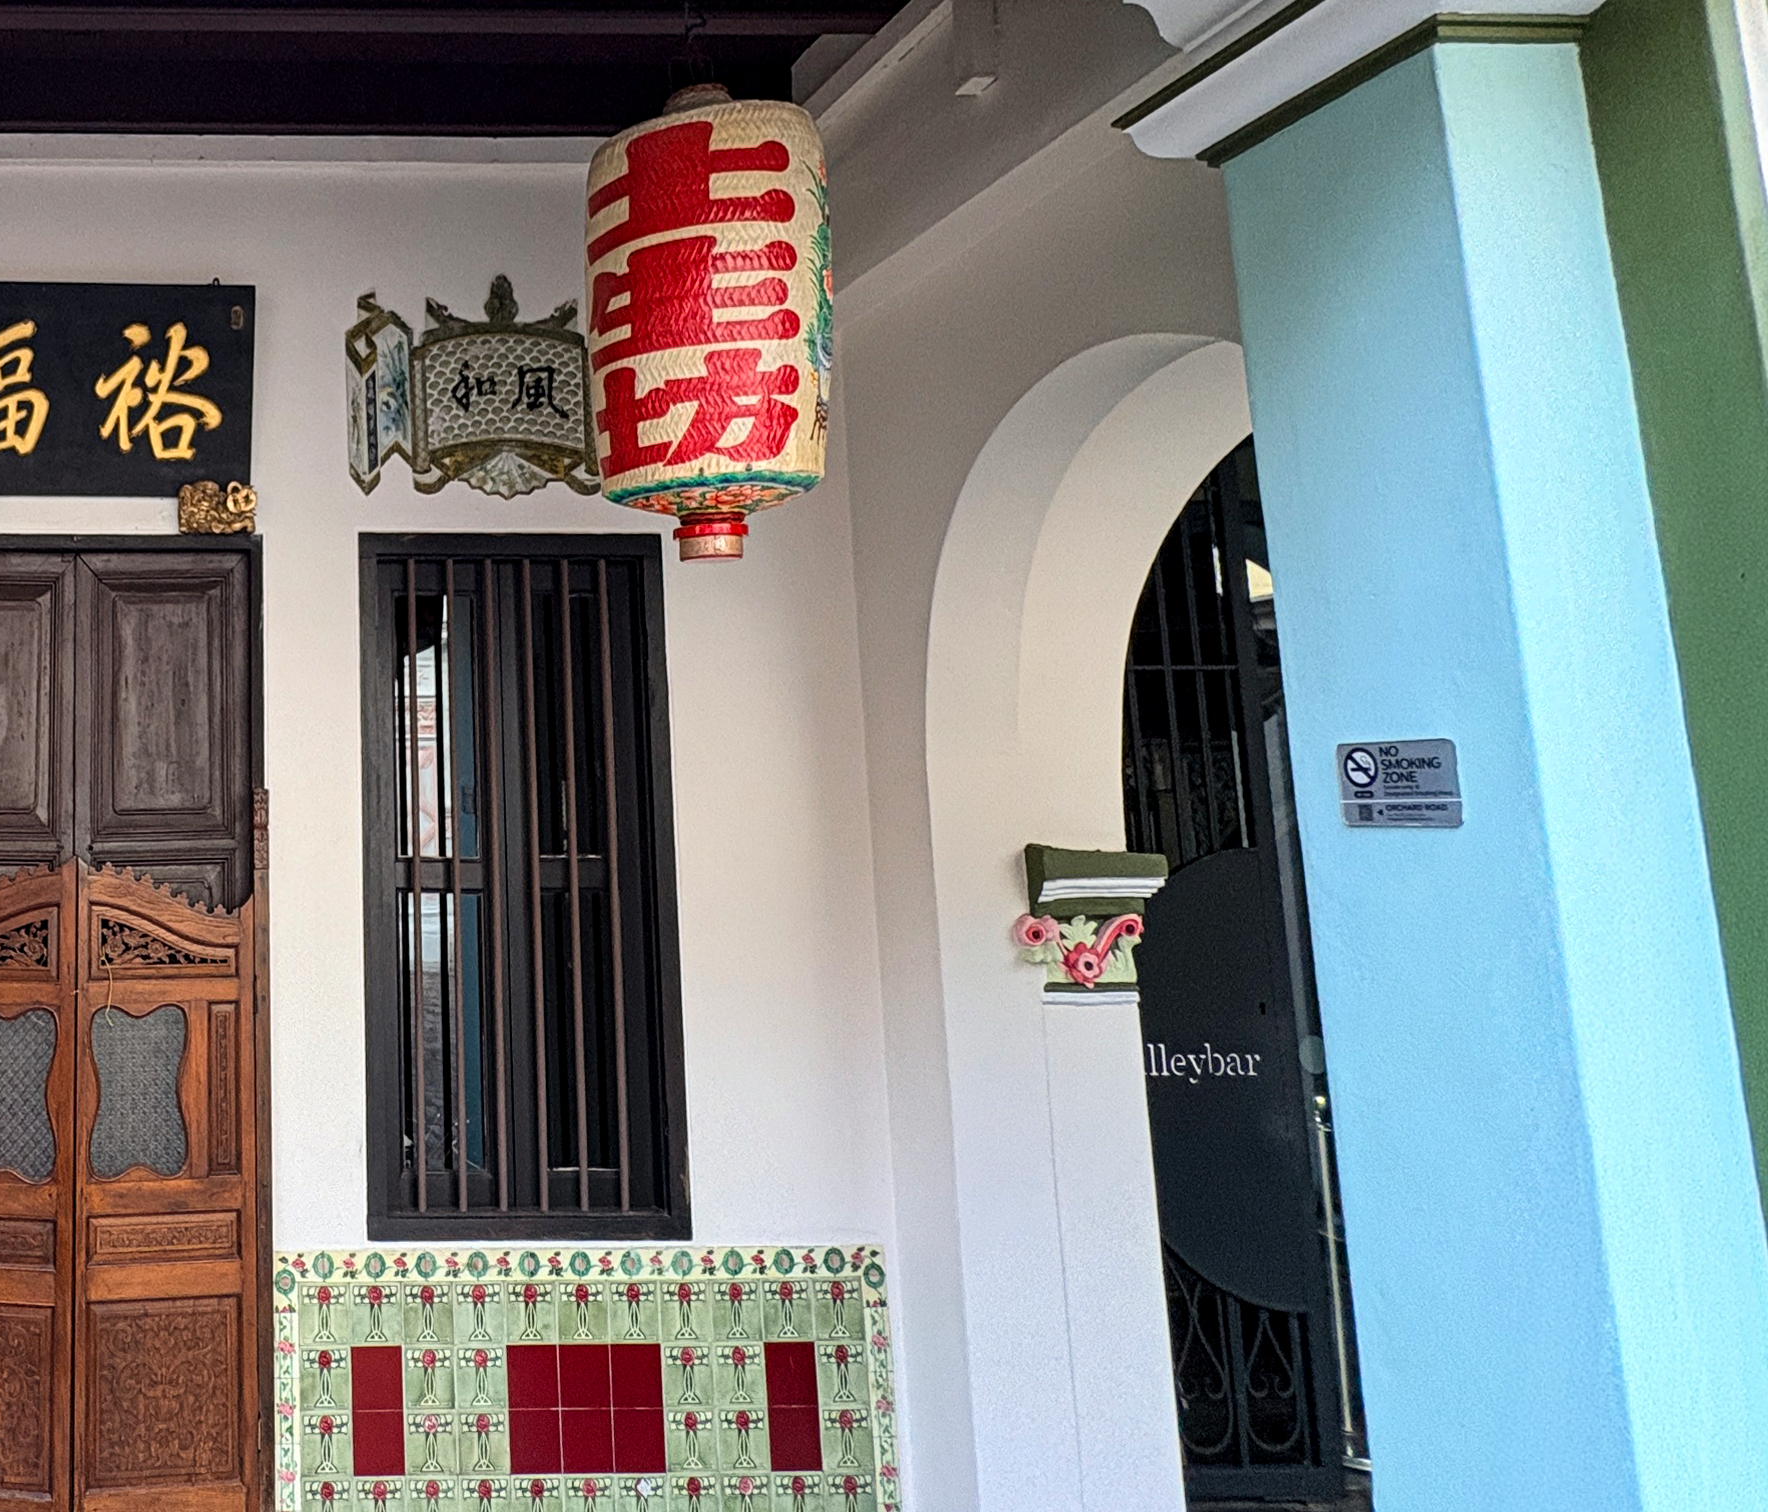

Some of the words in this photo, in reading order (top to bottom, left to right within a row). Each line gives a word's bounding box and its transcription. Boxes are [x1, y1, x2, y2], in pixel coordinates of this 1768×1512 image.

[1378, 746, 1399, 758] NO
[1380, 756, 1442, 771] SMOKING
[1382, 770, 1418, 784] ZONE
[1144, 1042, 1261, 1084] lleybar
